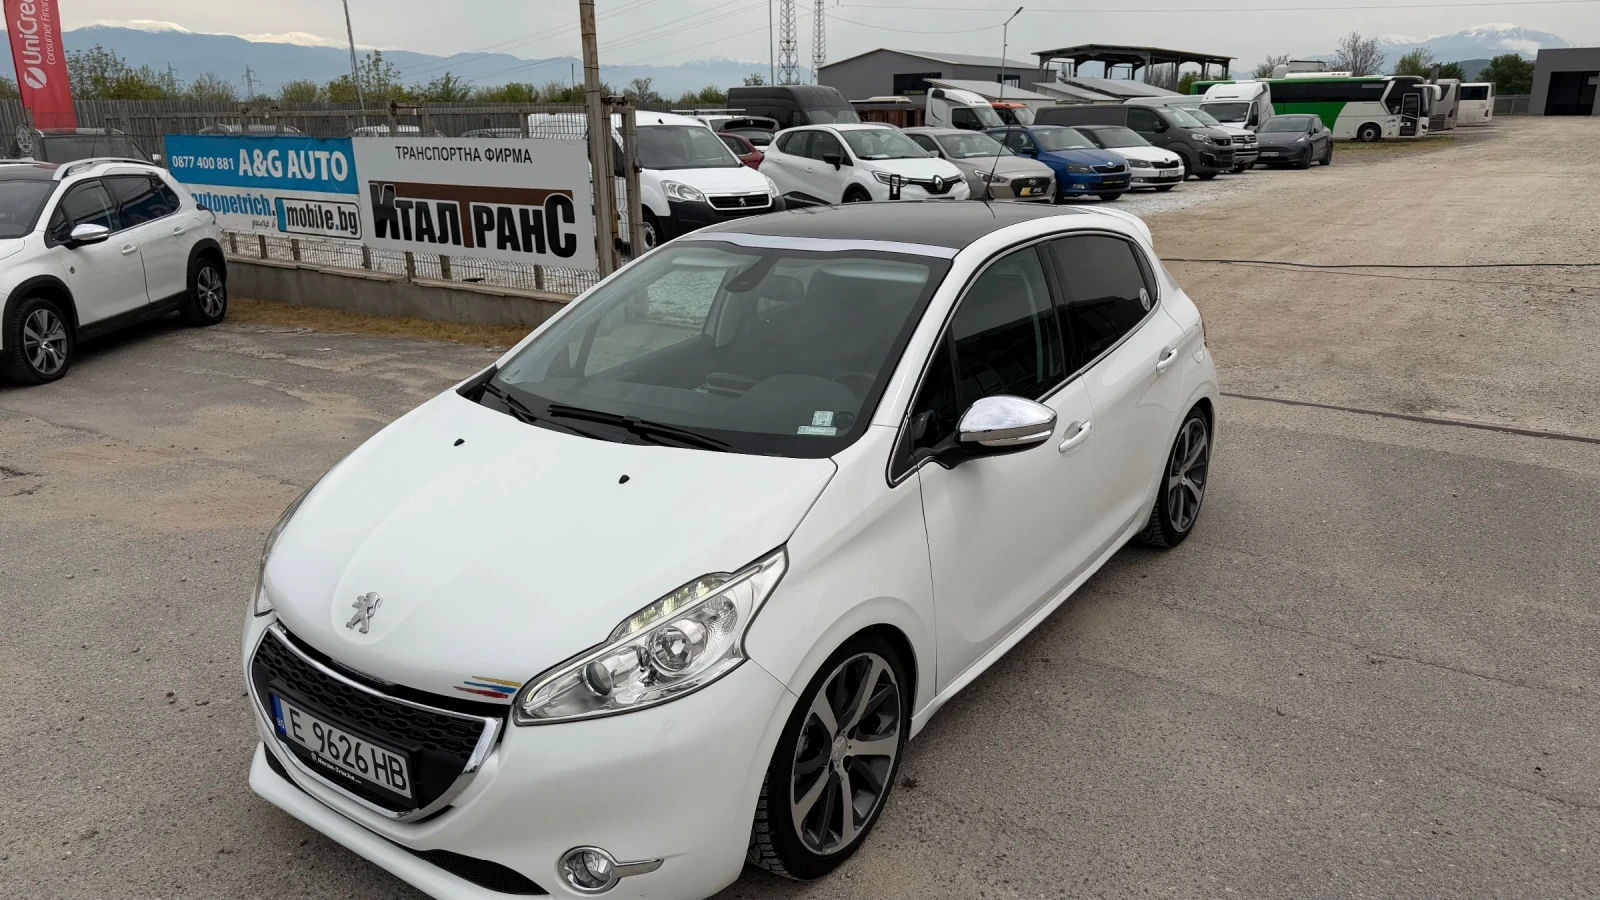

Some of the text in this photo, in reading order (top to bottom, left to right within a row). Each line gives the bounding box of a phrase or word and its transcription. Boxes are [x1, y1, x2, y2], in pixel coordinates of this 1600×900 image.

[17, 0, 42, 65] UniCre
[43, 23, 56, 65] Consumer
[172, 155, 235, 171] 0877 400 881
[239, 148, 349, 182] A&G AUTO
[395, 146, 533, 164] ТРАНСПОРТНА ФИРМА
[286, 203, 359, 235] mobile.bg
